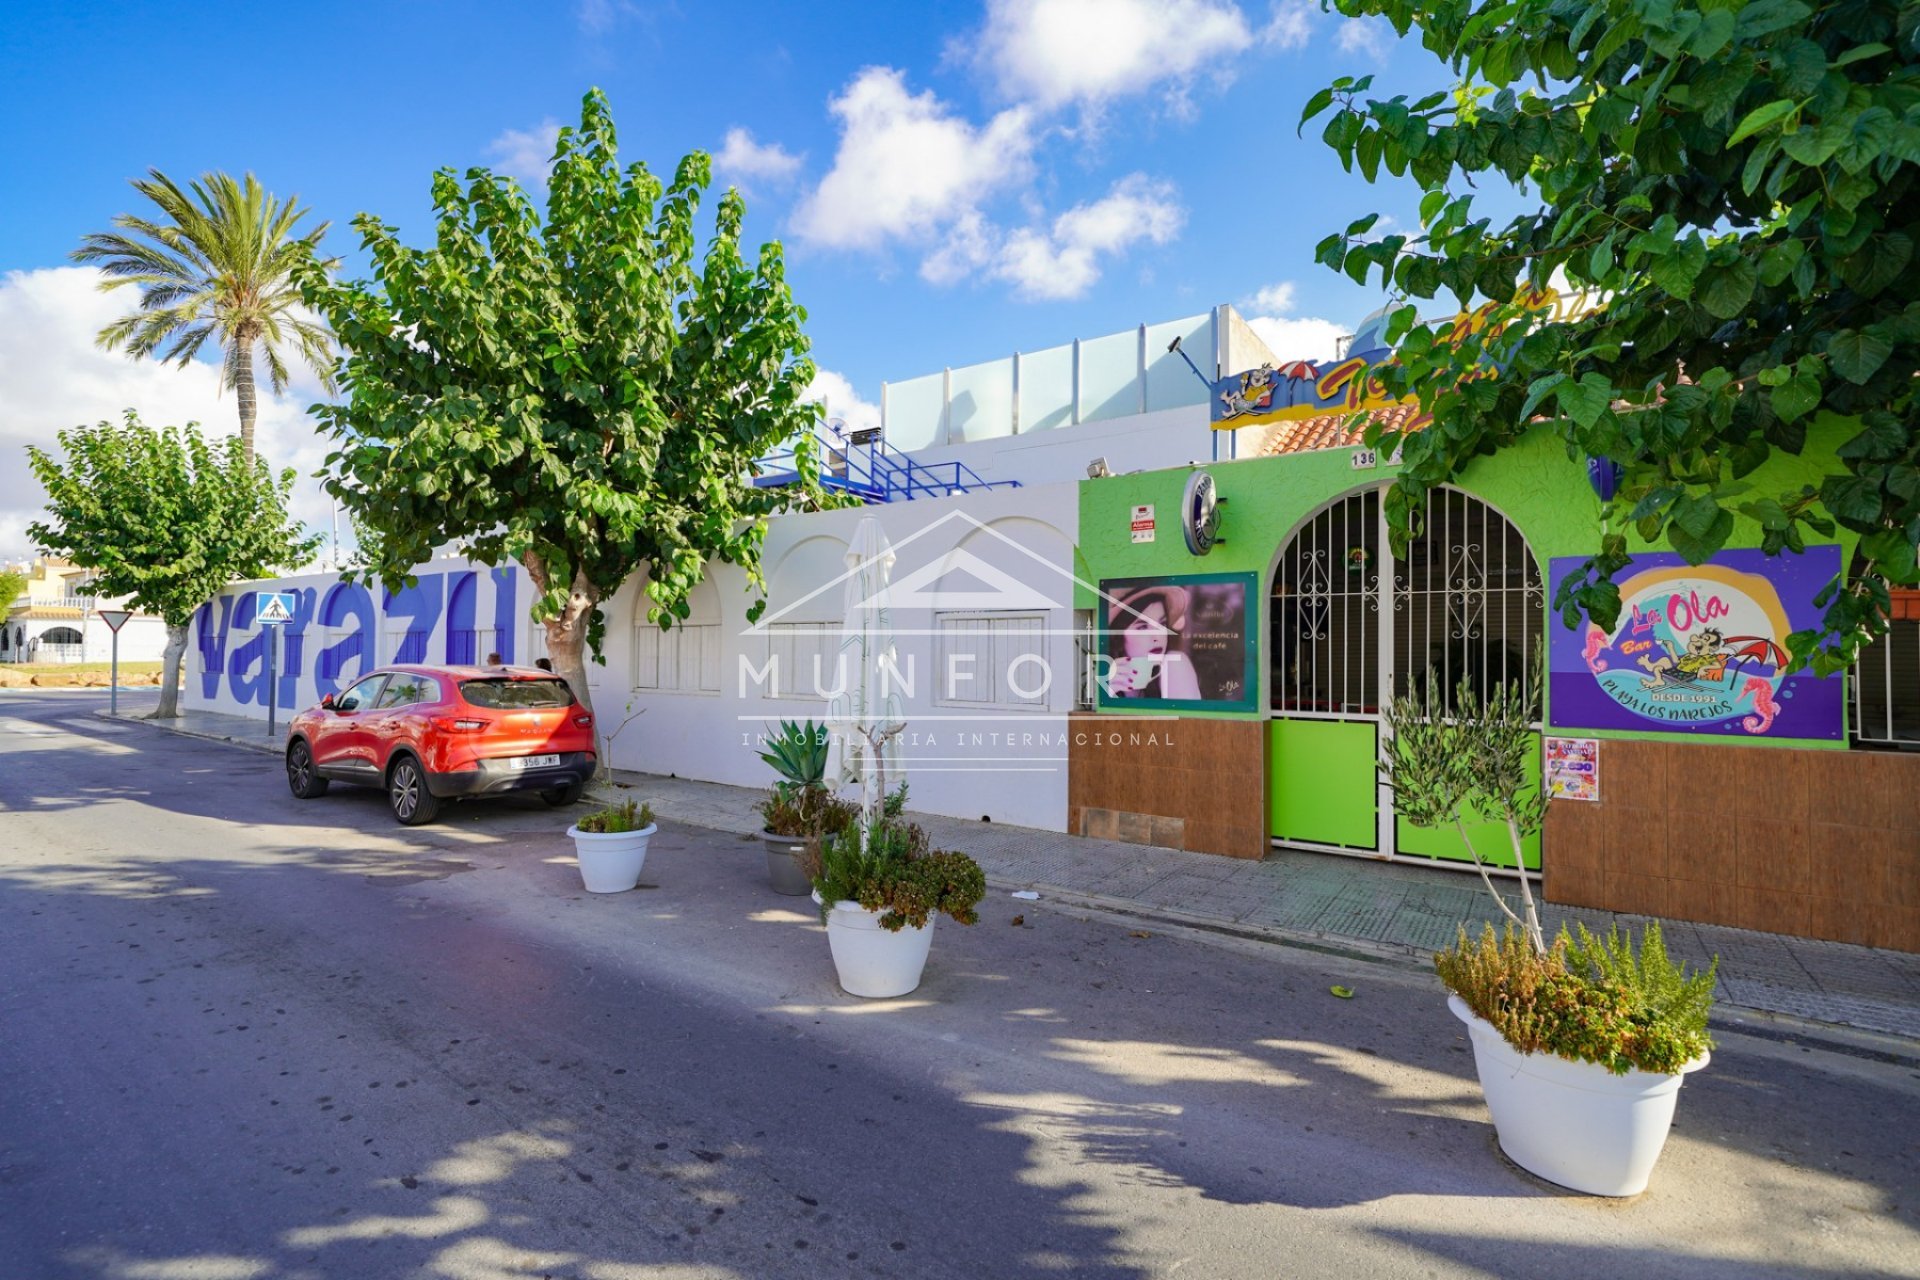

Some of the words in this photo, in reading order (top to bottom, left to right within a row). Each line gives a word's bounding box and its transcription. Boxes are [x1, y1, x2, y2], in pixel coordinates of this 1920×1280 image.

[1352, 452, 1375, 466] 136
[1631, 603, 1662, 635] La
[1667, 590, 1729, 632] Ola
[1193, 631, 1239, 639] excelencia
[1193, 642, 1206, 650] del
[1208, 642, 1227, 650] café
[1620, 640, 1652, 655] Bar
[1602, 679, 1639, 709] PLAYA
[1641, 702, 1666, 719] LOS
[1669, 700, 1733, 720] NAREJOS
[1651, 693, 1687, 702] DESDE
[1691, 695, 1717, 703] 1991
